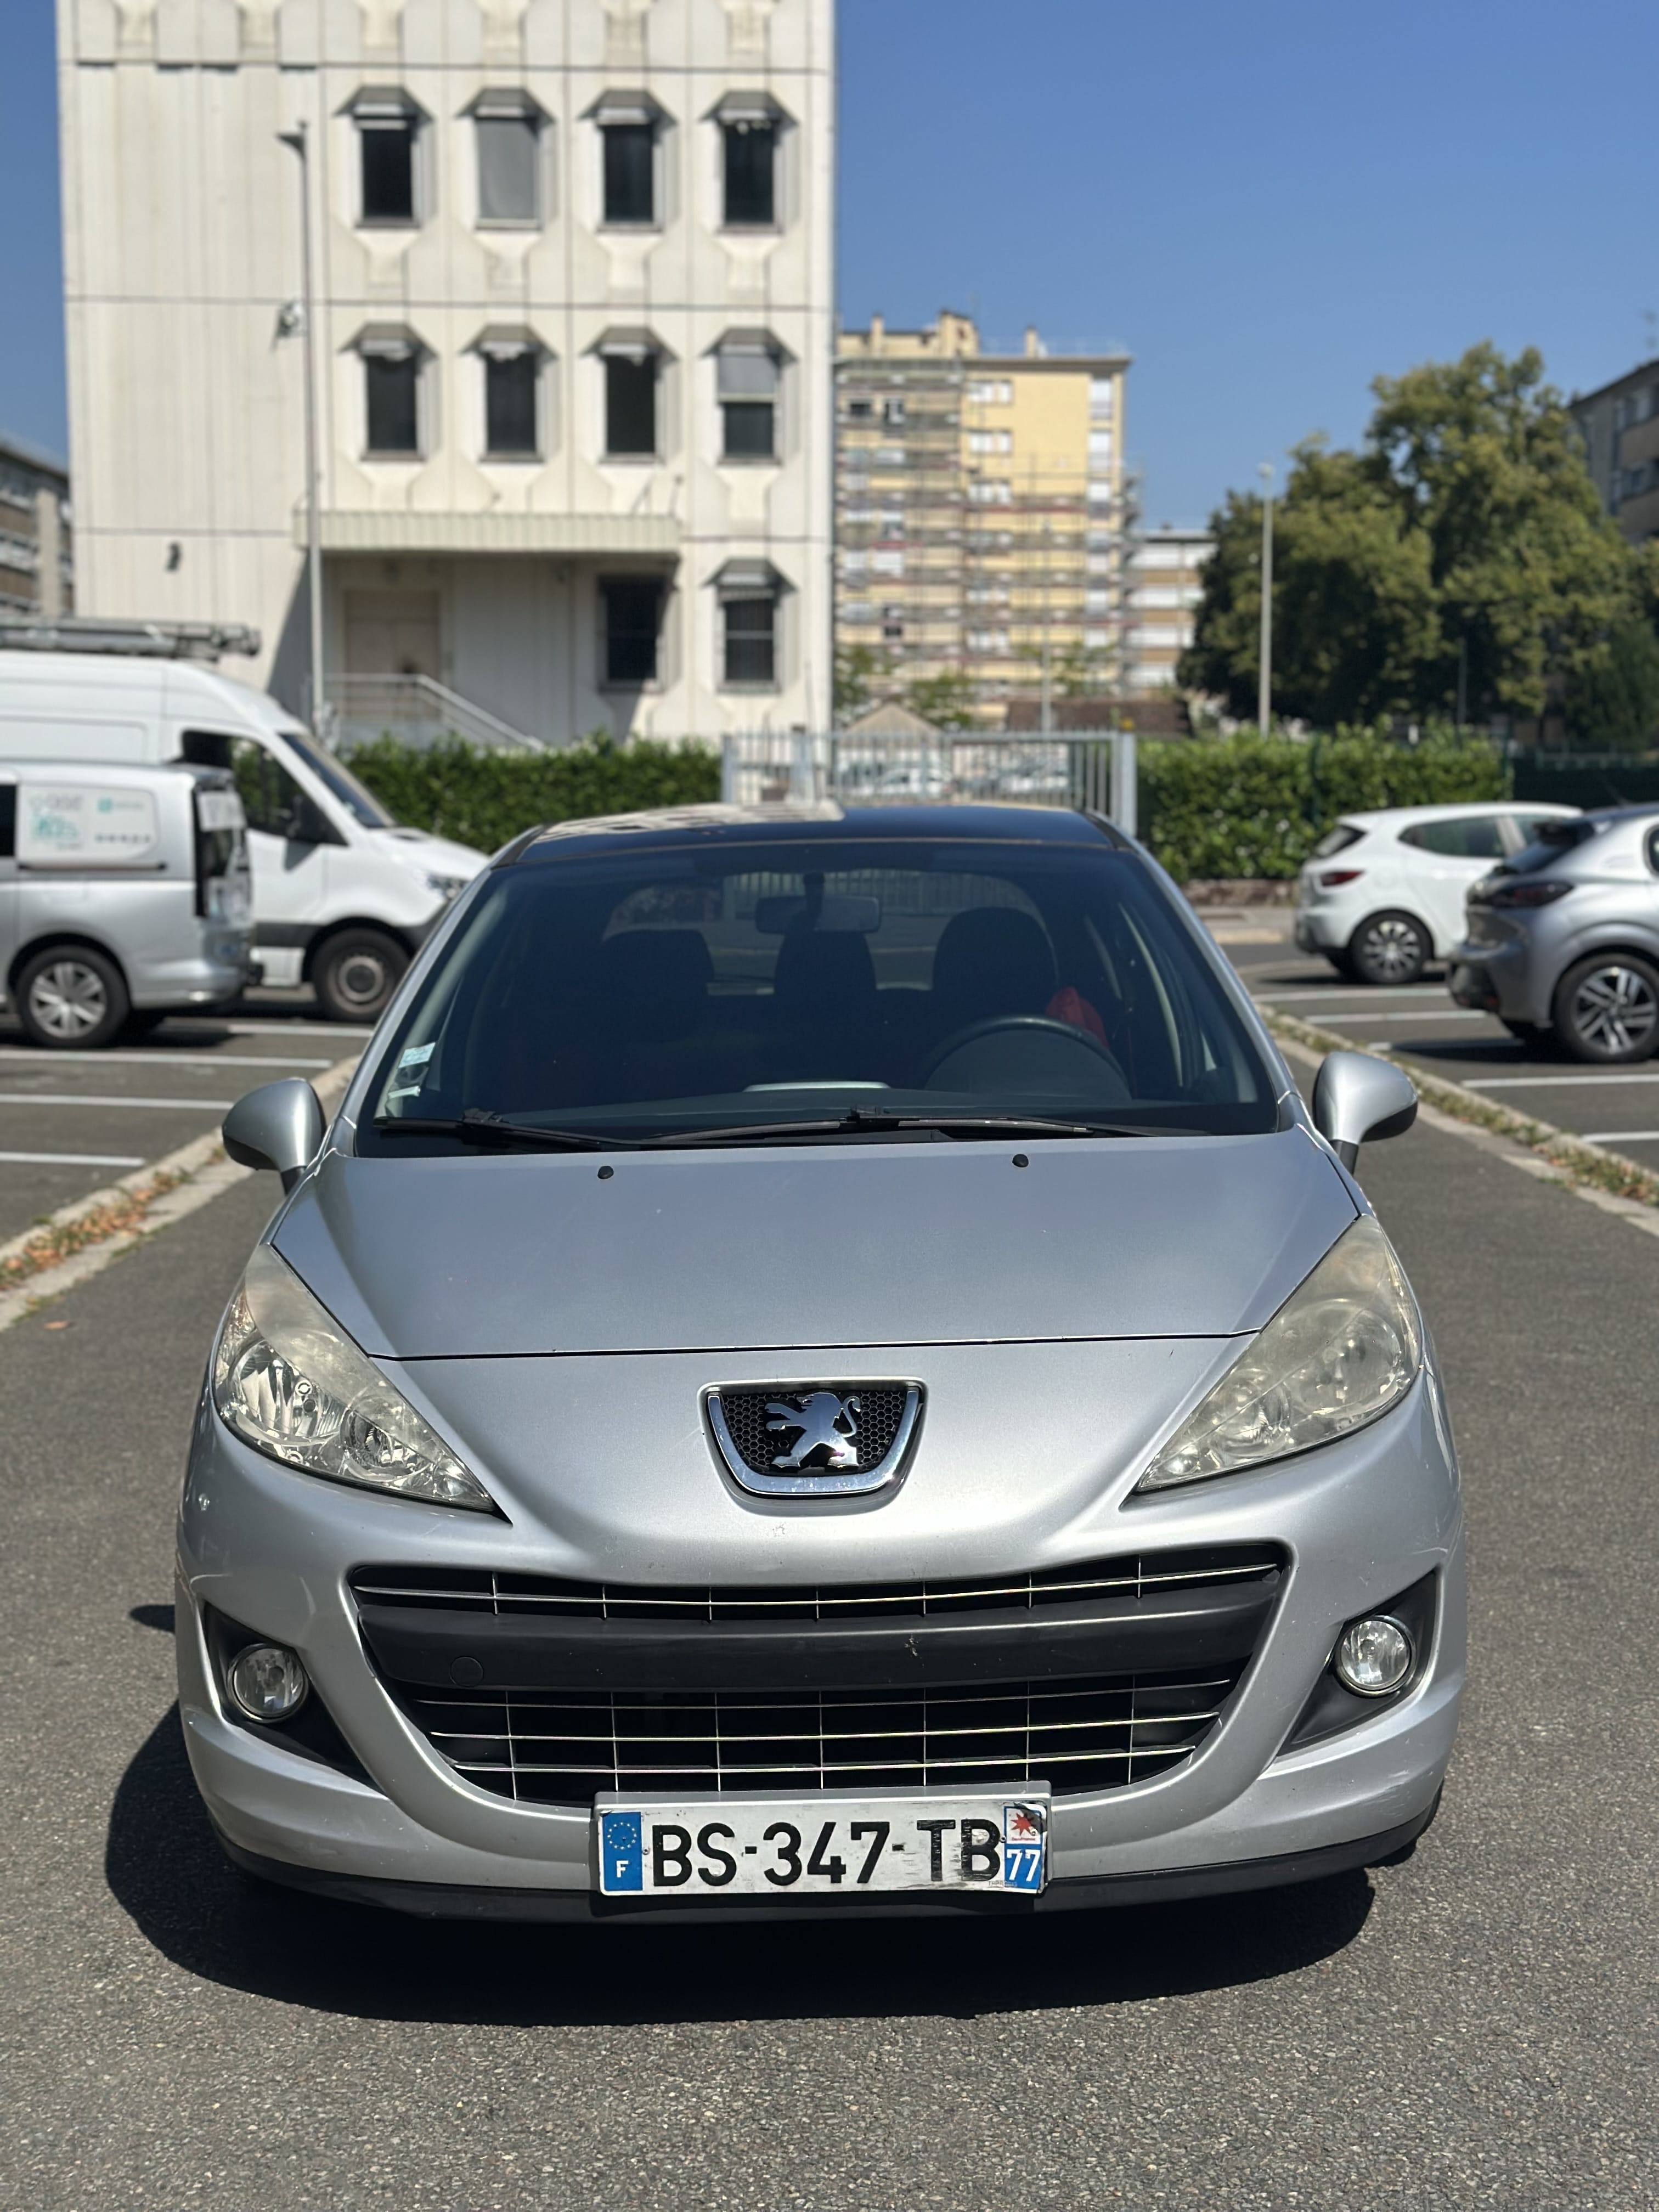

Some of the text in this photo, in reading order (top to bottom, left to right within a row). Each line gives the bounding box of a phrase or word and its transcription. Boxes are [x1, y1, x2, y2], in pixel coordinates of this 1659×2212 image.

[616, 1860, 629, 1877] F
[652, 1819, 1001, 1887] BS-347-TB
[1006, 1849, 1041, 1882] 77
